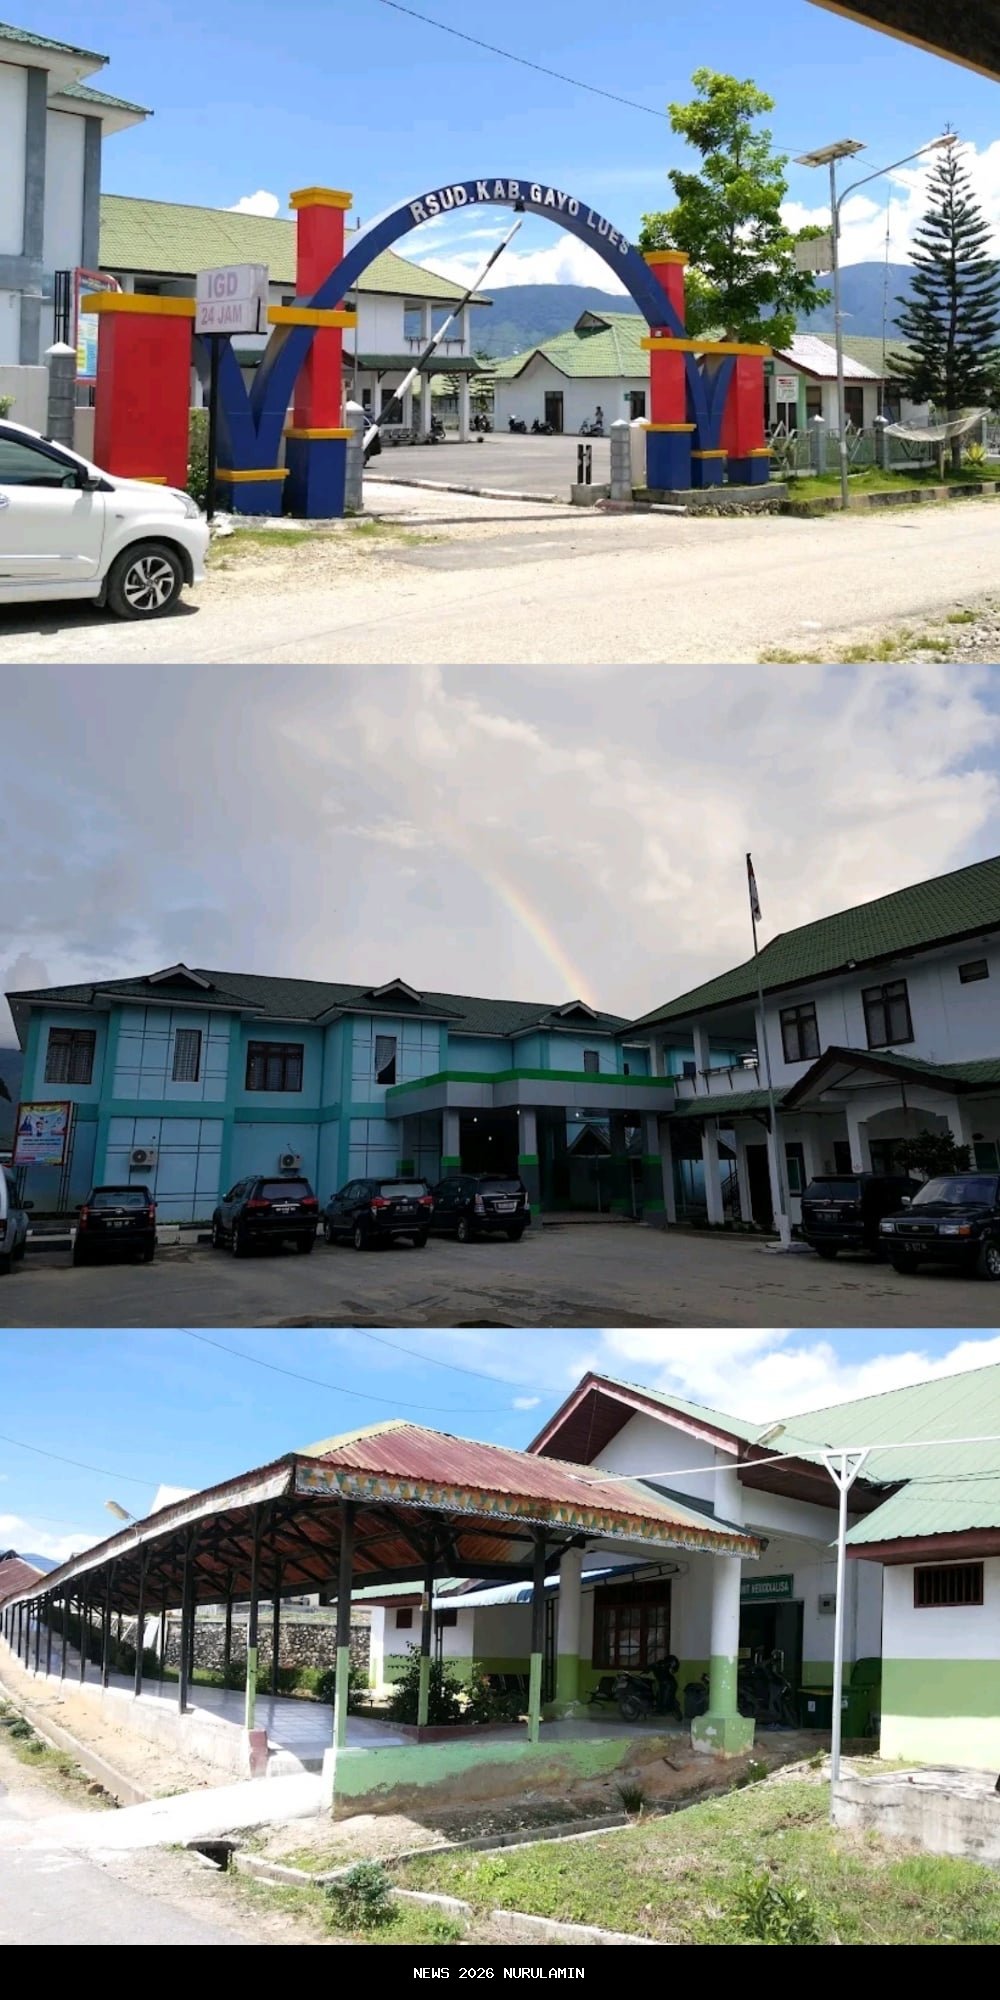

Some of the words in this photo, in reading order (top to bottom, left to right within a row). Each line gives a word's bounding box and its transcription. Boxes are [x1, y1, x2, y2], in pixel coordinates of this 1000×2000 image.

[530, 184, 579, 217] GAYO
[586, 210, 629, 256] LUES
[207, 272, 238, 299] IGD
[201, 307, 215, 326] 24
[217, 303, 242, 325] JAM
